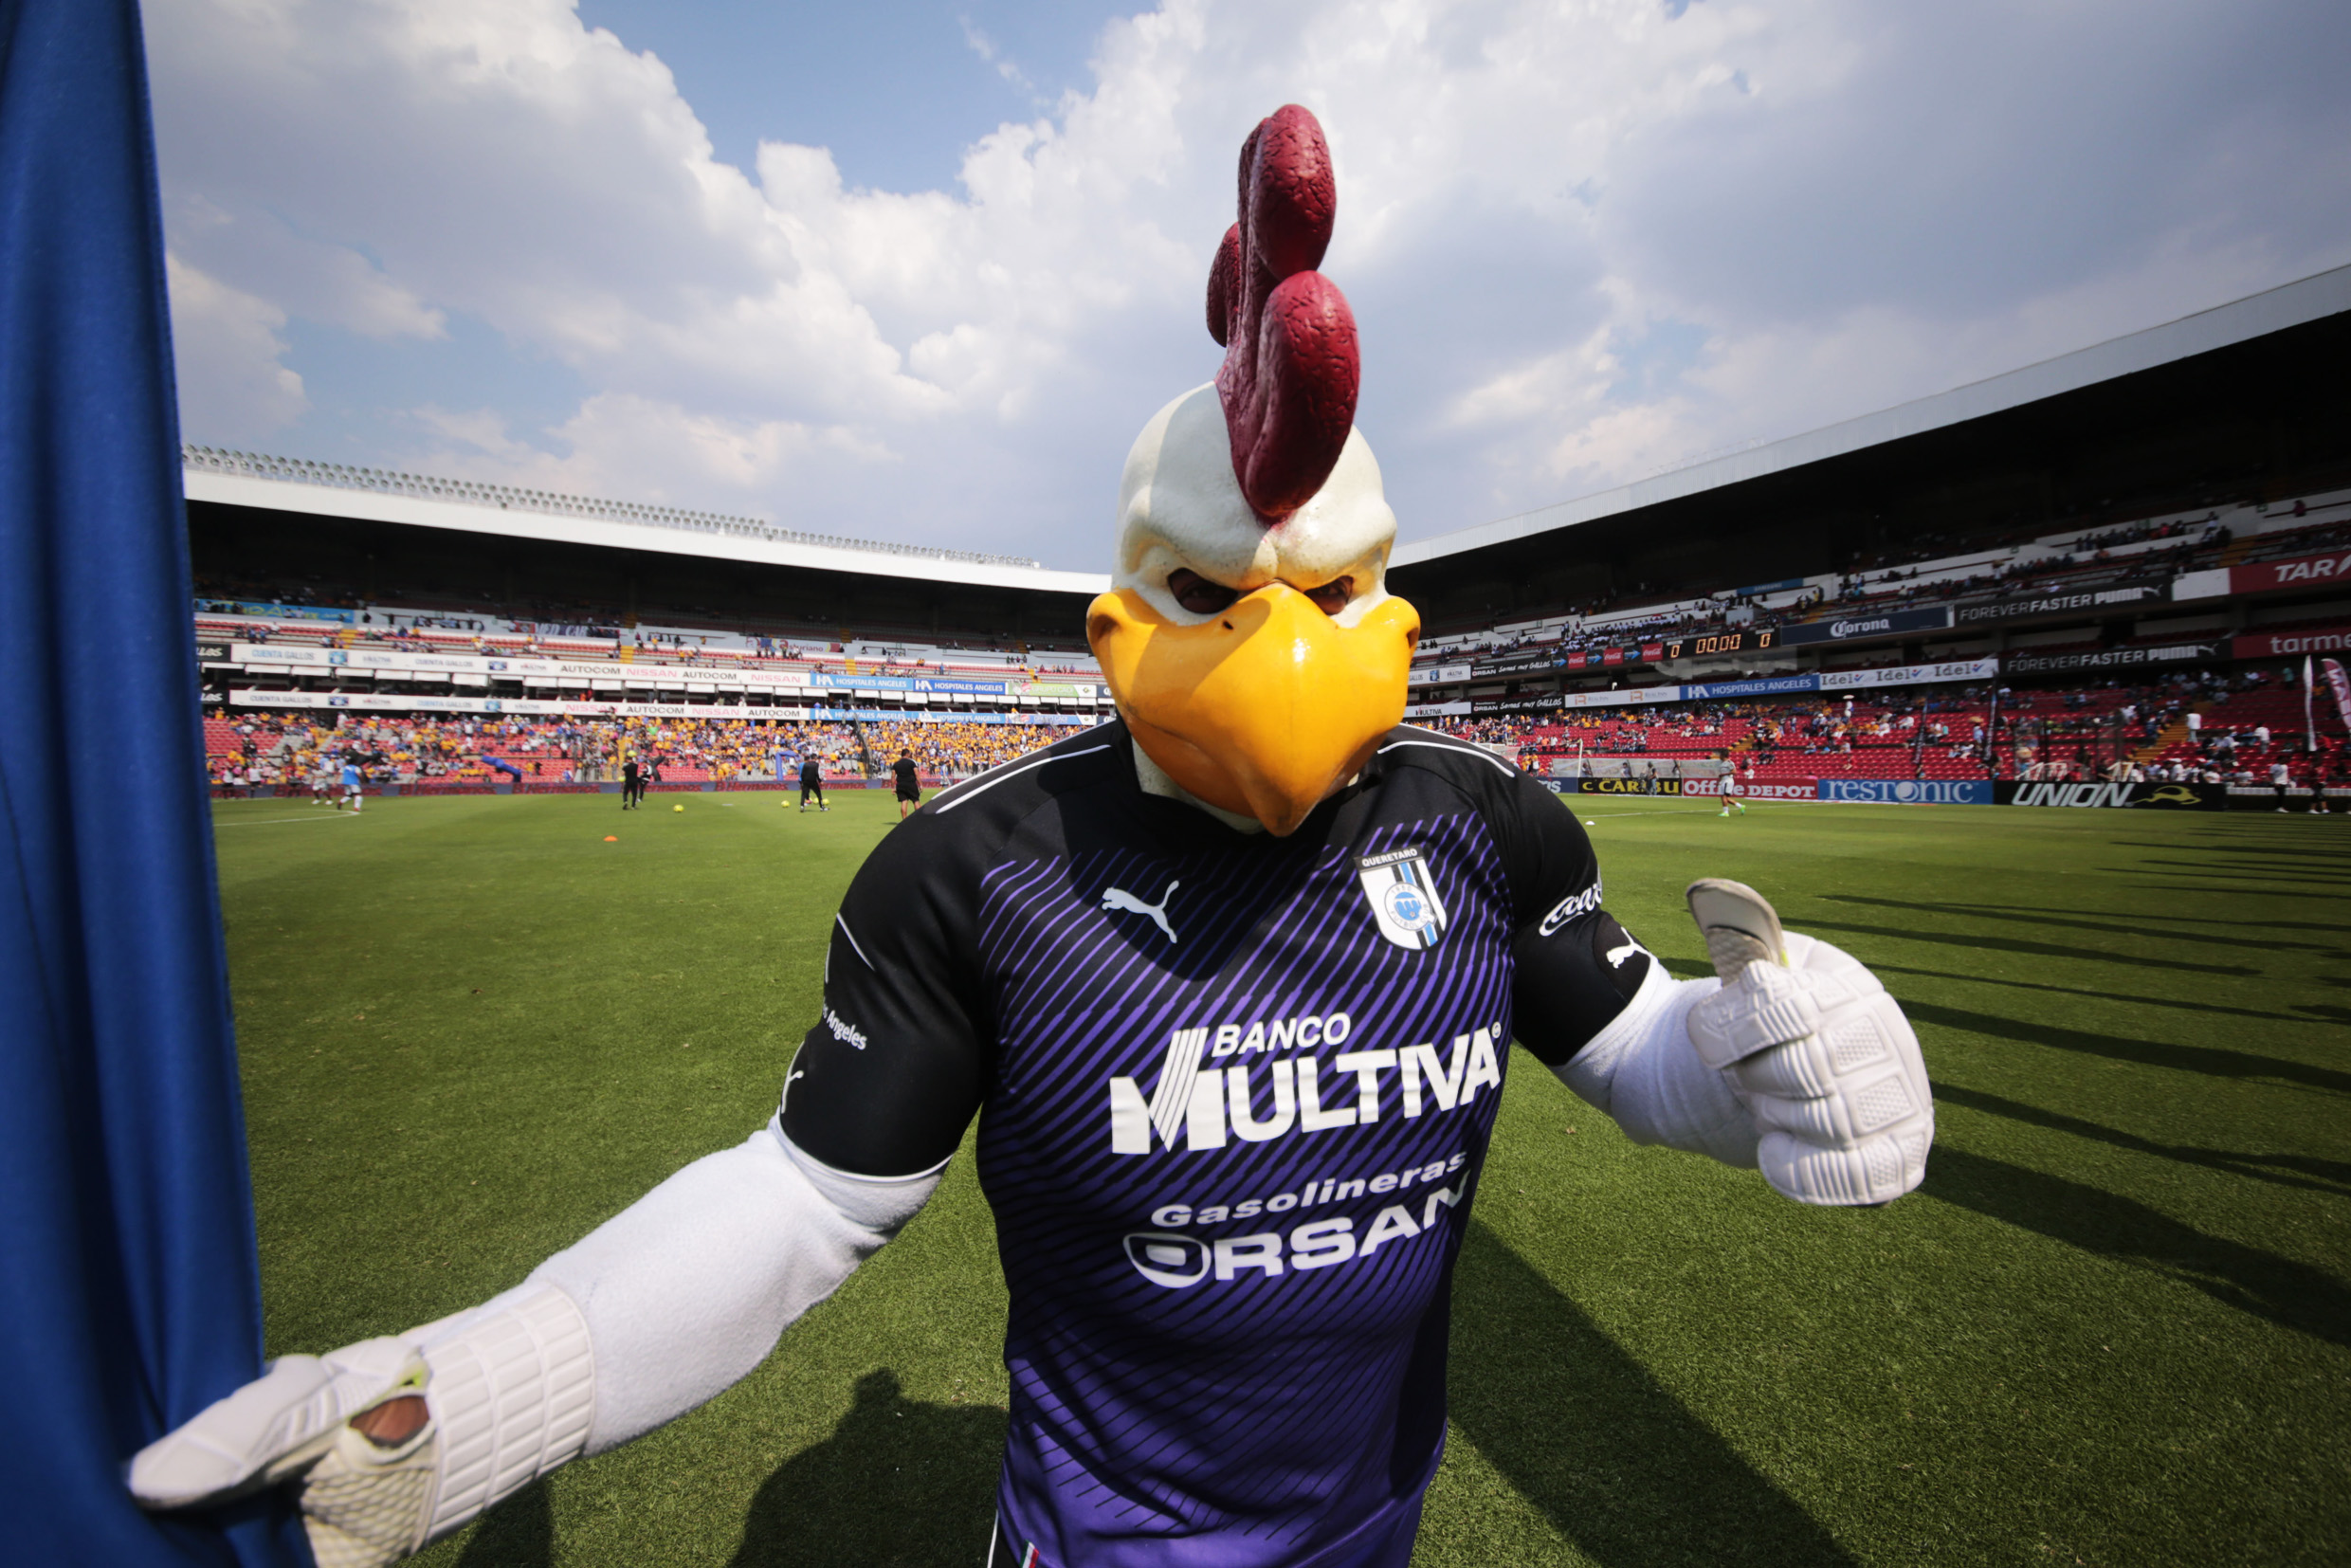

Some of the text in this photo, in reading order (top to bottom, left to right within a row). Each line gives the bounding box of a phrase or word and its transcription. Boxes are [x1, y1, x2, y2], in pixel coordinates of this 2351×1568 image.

[2094, 587, 2142, 605] PUMA
[1830, 619, 1890, 638] Corona
[1670, 645, 1680, 658] 0
[1759, 633, 1771, 647] 0
[251, 648, 315, 660] CUENTA GALLOS
[2147, 645, 2198, 661] PUMA
[560, 665, 621, 675] AUTOCOM
[627, 668, 677, 678] NISSAN
[683, 671, 737, 680] AUTOCOM
[1876, 668, 1910, 682] Idel
[1935, 664, 1971, 677] Idel
[751, 674, 801, 684] NISSAN
[836, 678, 876, 686] HOSPITALES
[878, 679, 907, 688] ANGELES
[1821, 672, 1852, 685] Idel
[935, 683, 973, 691] HOSPITALES
[975, 684, 1003, 692] ANGELES
[1712, 683, 1765, 695] HOSPITALES
[1767, 679, 1812, 690] ANGELES
[566, 703, 618, 712] NISSAN
[627, 706, 684, 715] AUTOCOM
[692, 707, 740, 716] NISSAN
[748, 709, 800, 718] AUTOCOM
[1685, 780, 1814, 796] Offie DEPOT
[2012, 783, 2136, 808] UNION
[826, 1010, 867, 1049] Angeles
[1212, 1012, 1351, 1058] BANCO
[1109, 1027, 1501, 1155] MULTIVA
[1151, 1151, 1467, 1228] Gasolineras
[1122, 1169, 1470, 1288] ORSAN
